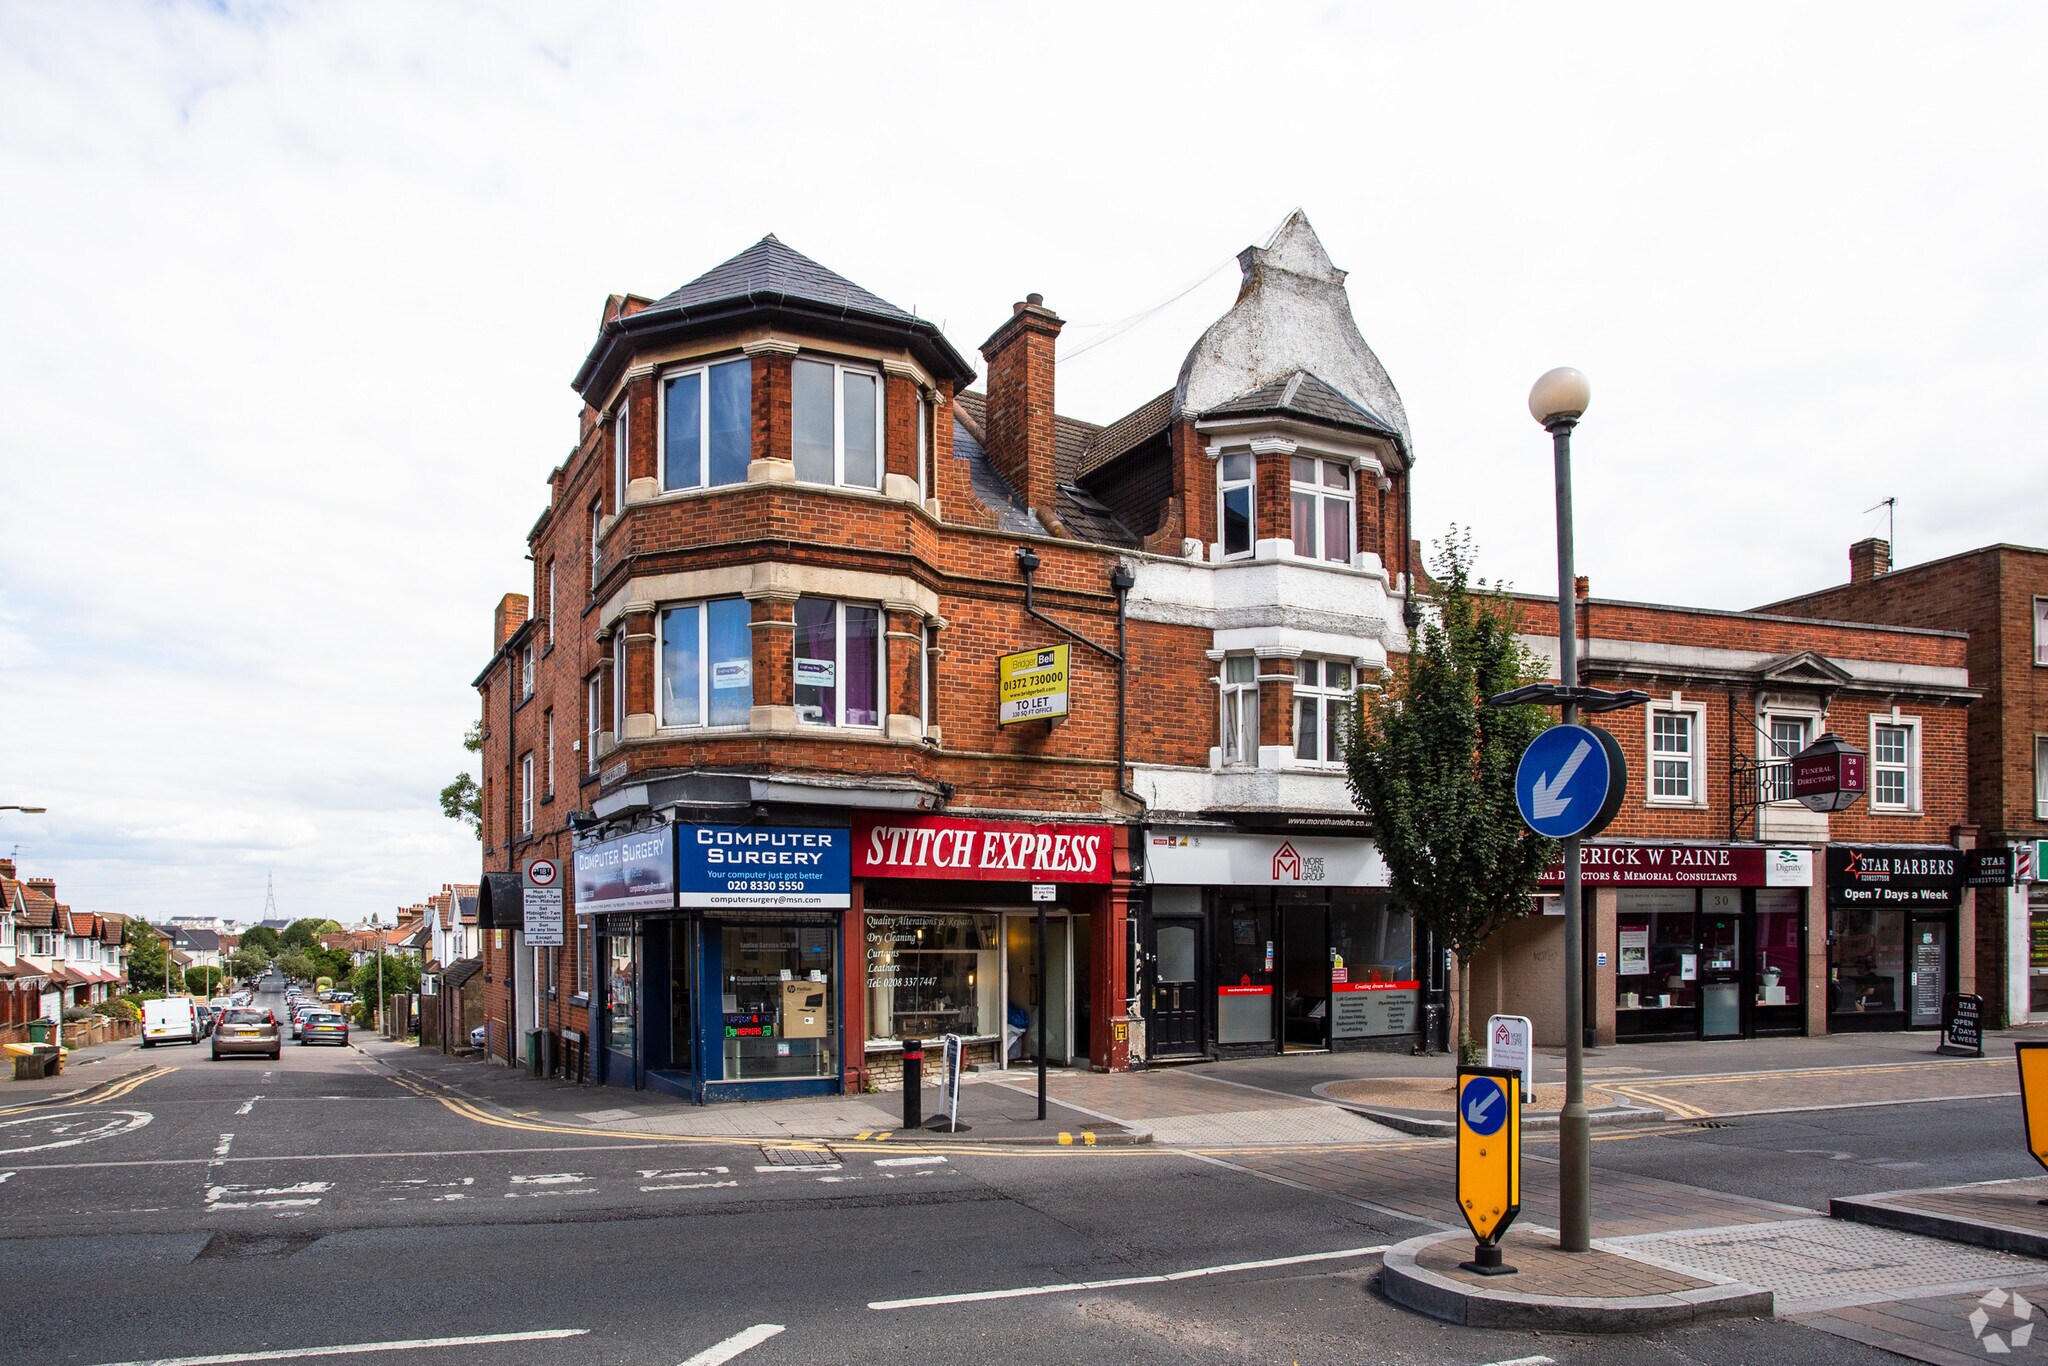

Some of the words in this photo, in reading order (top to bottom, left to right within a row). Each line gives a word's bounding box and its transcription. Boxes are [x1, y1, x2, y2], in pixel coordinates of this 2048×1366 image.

[1012, 658, 1035, 669] Bridger
[1038, 653, 1054, 665] Bell
[1003, 678, 1027, 691] 01372
[1030, 672, 1063, 686] 730000
[1010, 687, 1056, 698] www.bridgerbell.com
[1016, 700, 1029, 710] TO
[1032, 697, 1049, 708] LET
[1035, 706, 1052, 714] OFFICE
[1801, 766, 1832, 776] FUNERAL
[1797, 775, 1836, 786] DIRECTORS
[866, 826, 977, 868] STITCH
[978, 831, 1101, 873] EXPRESS
[1302, 857, 1324, 865] MORE
[1579, 848, 1641, 865] ERICK
[1647, 848, 1662, 865] W
[1671, 849, 1730, 866] PAINE
[1981, 857, 2006, 866] STAR
[1304, 865, 1324, 873] THAN
[1775, 863, 1801, 874] Dignity
[1861, 859, 1890, 872] STAR
[1894, 858, 1954, 875] BARBERS
[707, 870, 726, 878] Your
[727, 871, 767, 880] computer
[768, 872, 783, 880] just
[799, 872, 823, 880] better
[1301, 873, 1325, 881] GROUP
[1613, 871, 1621, 881] &
[1624, 871, 1673, 881] MEMORIAL
[1676, 871, 1737, 882] CONSULTANTS
[1968, 876, 2006, 884] 02083377558
[727, 881, 748, 890] 020
[750, 881, 776, 890] 8330
[778, 881, 804, 890] 5550
[1844, 888, 1872, 901] Open
[1874, 888, 1882, 898] 7
[1884, 889, 1909, 901] Days
[1911, 891, 1918, 899] a
[1920, 890, 1948, 900] Week
[710, 896, 821, 905] computersurgery@msn.com
[1714, 896, 1729, 906] 30
[866, 915, 896, 928] Quality
[896, 915, 937, 926] Alterations
[947, 918, 973, 928] Repairs
[867, 932, 882, 945] Dry
[884, 931, 916, 944] Cleaning
[867, 948, 900, 959] Curtains
[867, 963, 900, 973] Leathers
[867, 978, 881, 988] Tel:
[883, 977, 902, 987] 0208
[903, 977, 917, 987] 337
[919, 976, 937, 986] 7447
[1959, 1002, 1977, 1010] STAR
[726, 1015, 751, 1024] LAPTOP
[752, 1014, 759, 1023] &
[1953, 1018, 1973, 1026] OPEN
[737, 1027, 762, 1036] REPAIRS
[1951, 1025, 1958, 1033] 7
[1958, 1028, 1977, 1036] DAYS
[1957, 1035, 1978, 1044] WEEK
